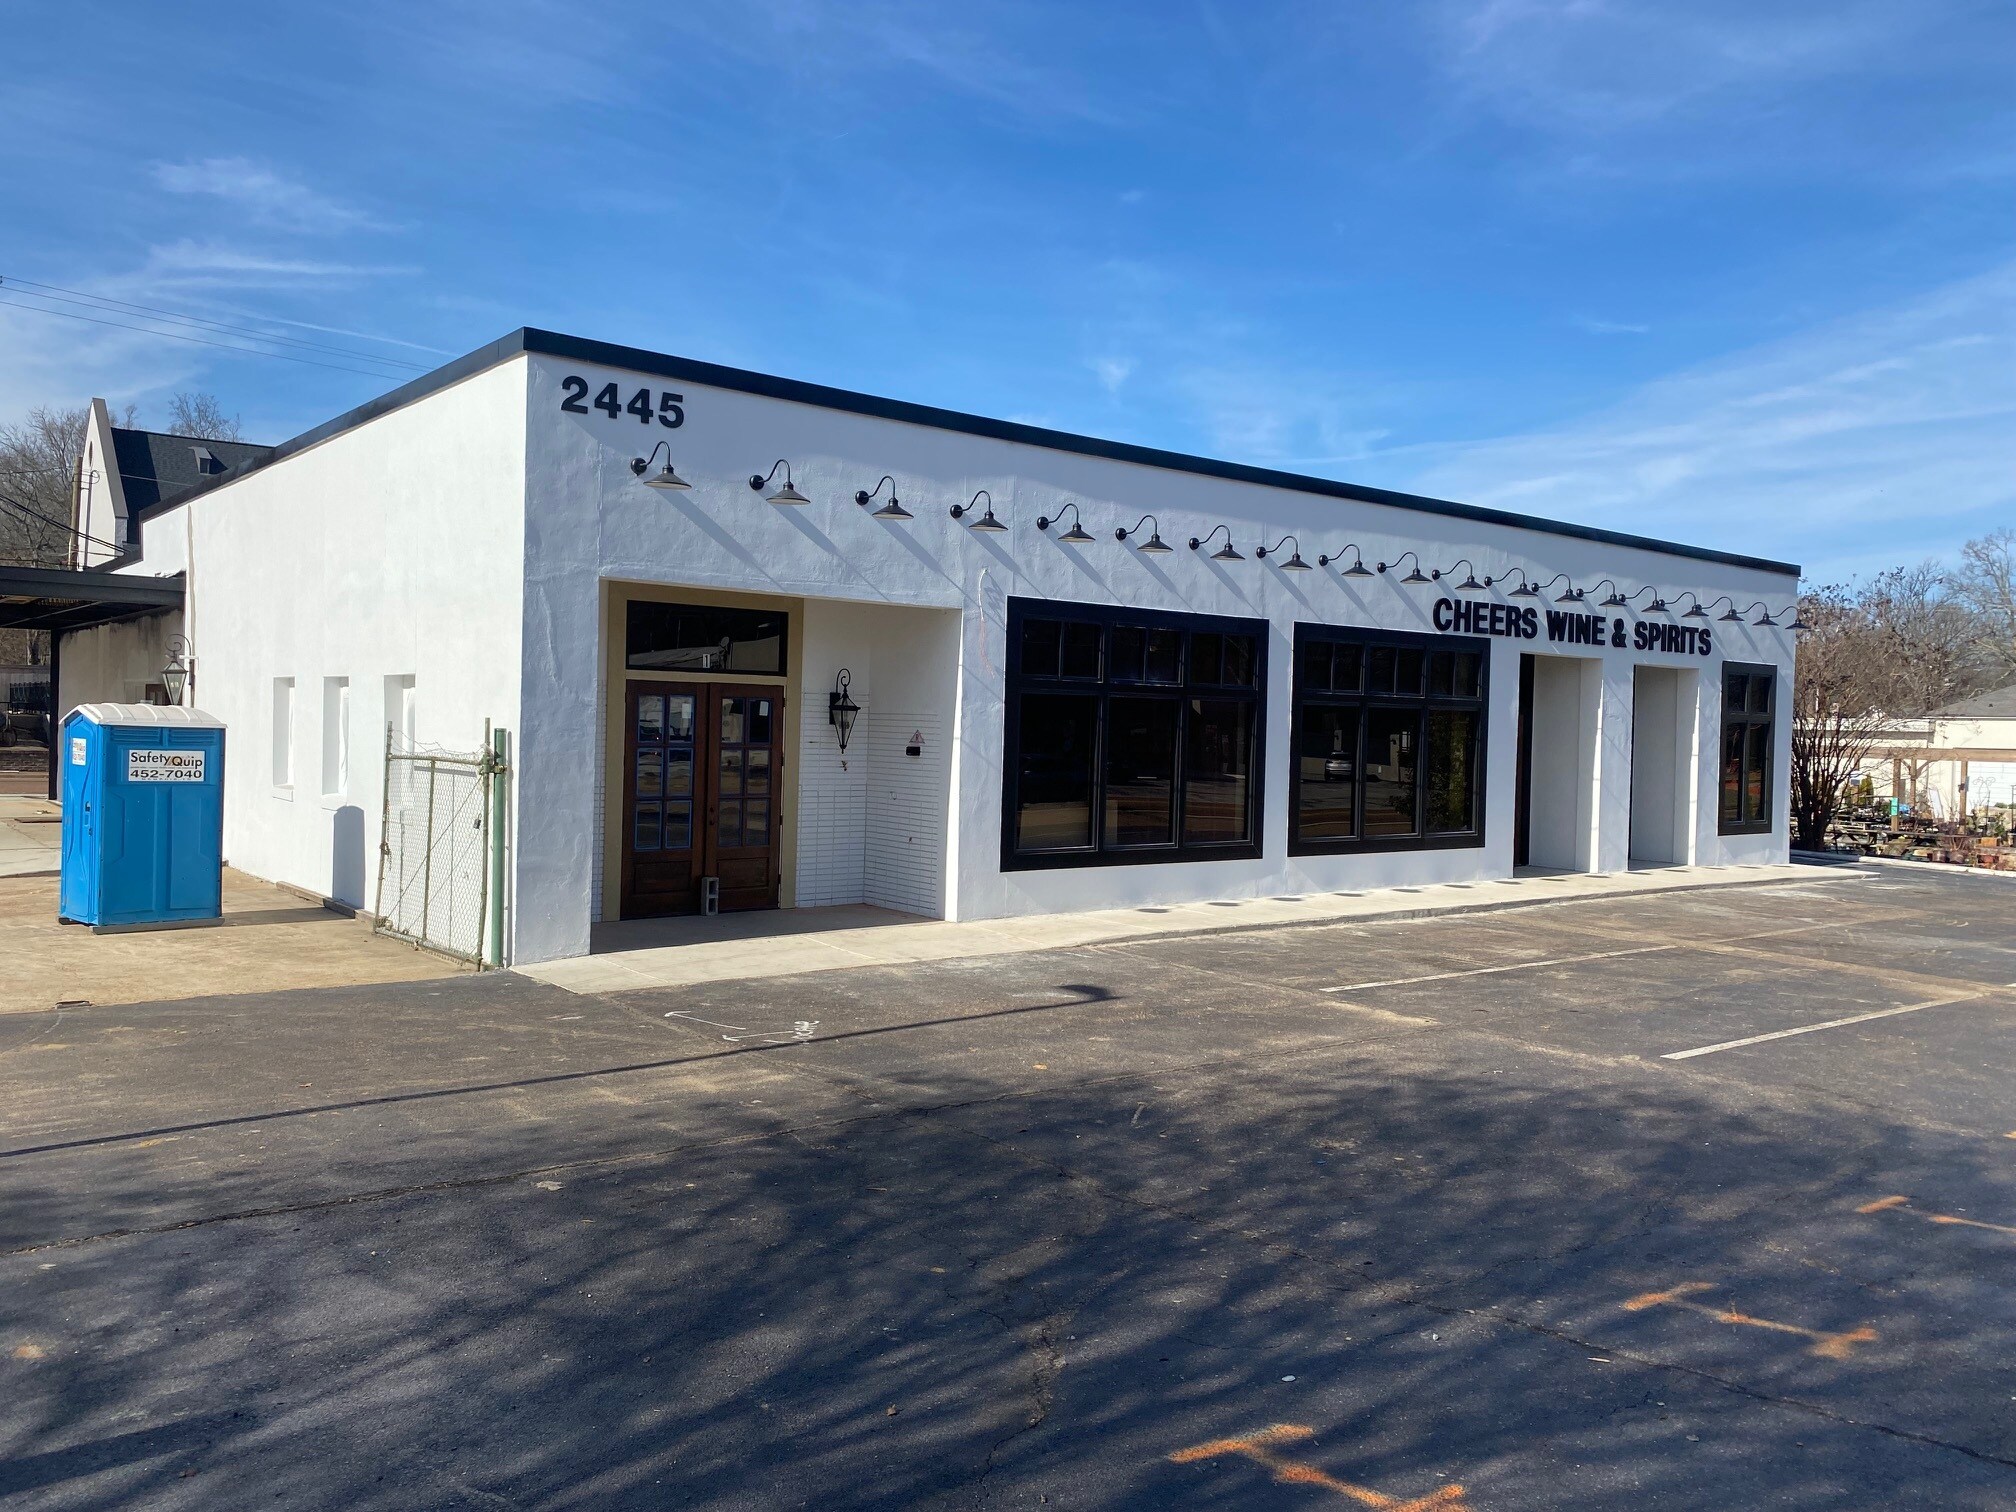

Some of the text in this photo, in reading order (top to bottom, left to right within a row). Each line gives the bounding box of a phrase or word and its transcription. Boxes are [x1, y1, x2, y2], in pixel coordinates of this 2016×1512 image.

[561, 375, 685, 429] 2445
[1433, 597, 1712, 656] CHEERS WINE & SPIRITS
[130, 769, 203, 778] 452-7040
